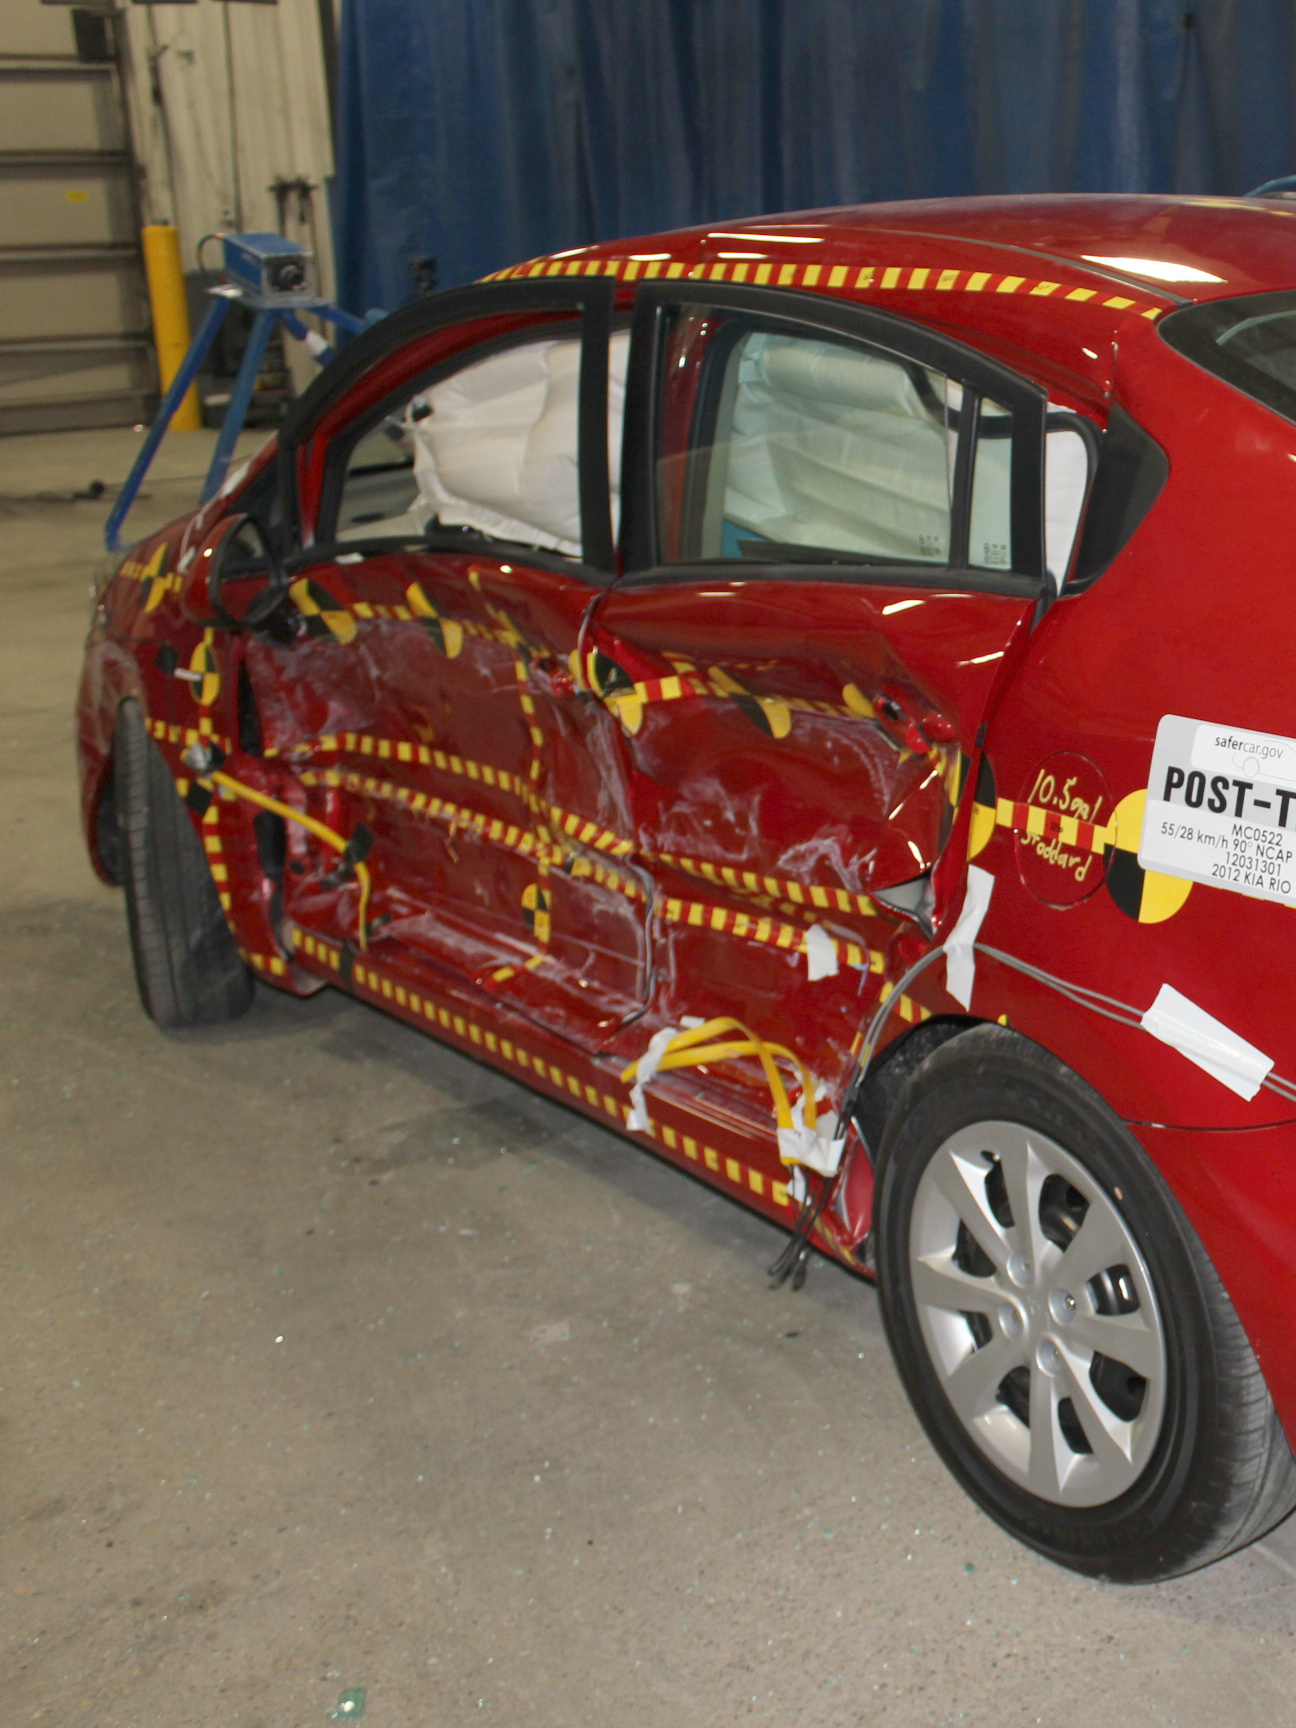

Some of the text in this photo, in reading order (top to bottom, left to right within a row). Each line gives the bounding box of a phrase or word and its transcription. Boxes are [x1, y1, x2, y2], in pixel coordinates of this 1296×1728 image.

[1214, 735, 1284, 759] safercar.gov
[1160, 821, 1194, 841] 55/28
[1197, 829, 1229, 850] km/h
[1255, 844, 1293, 865] NCAP
[1231, 823, 1283, 847] MC0522
[1225, 851, 1282, 877] 12031301
[1211, 864, 1291, 894] 2012 KIA RIO
